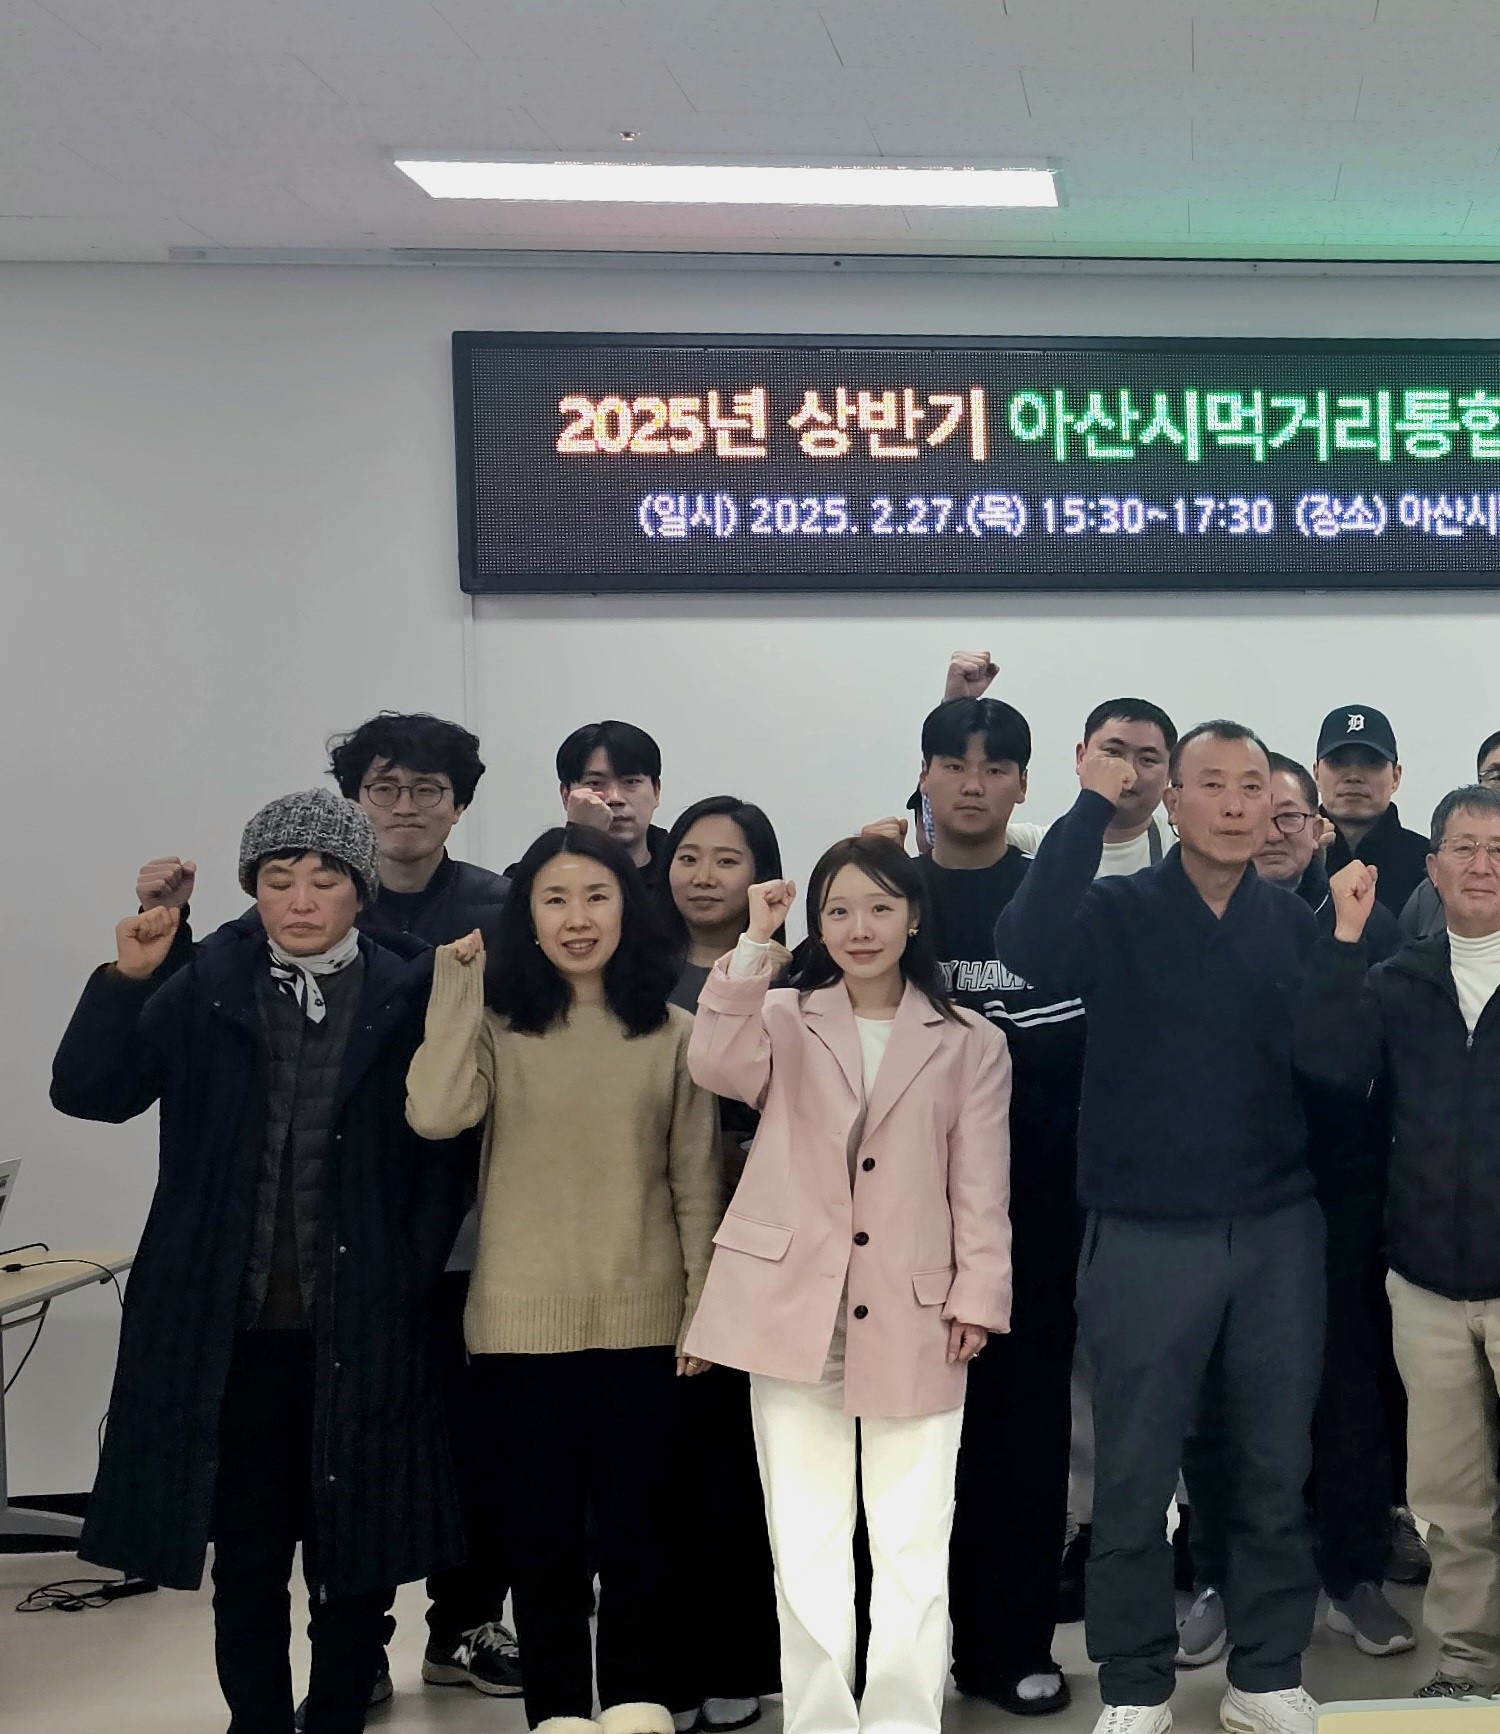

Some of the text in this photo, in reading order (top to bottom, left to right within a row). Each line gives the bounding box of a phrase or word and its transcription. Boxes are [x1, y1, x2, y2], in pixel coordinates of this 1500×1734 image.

[555, 387, 767, 458] 2025년
[787, 386, 986, 461] 상반기
[638, 493, 738, 538] (일시)
[750, 496, 858, 535] 2025.
[1042, 495, 1275, 535] 15:30~17:30
[1294, 493, 1389, 538] (장소)
[1346, 713, 1365, 734] D
[938, 959, 1035, 992] YHAW
